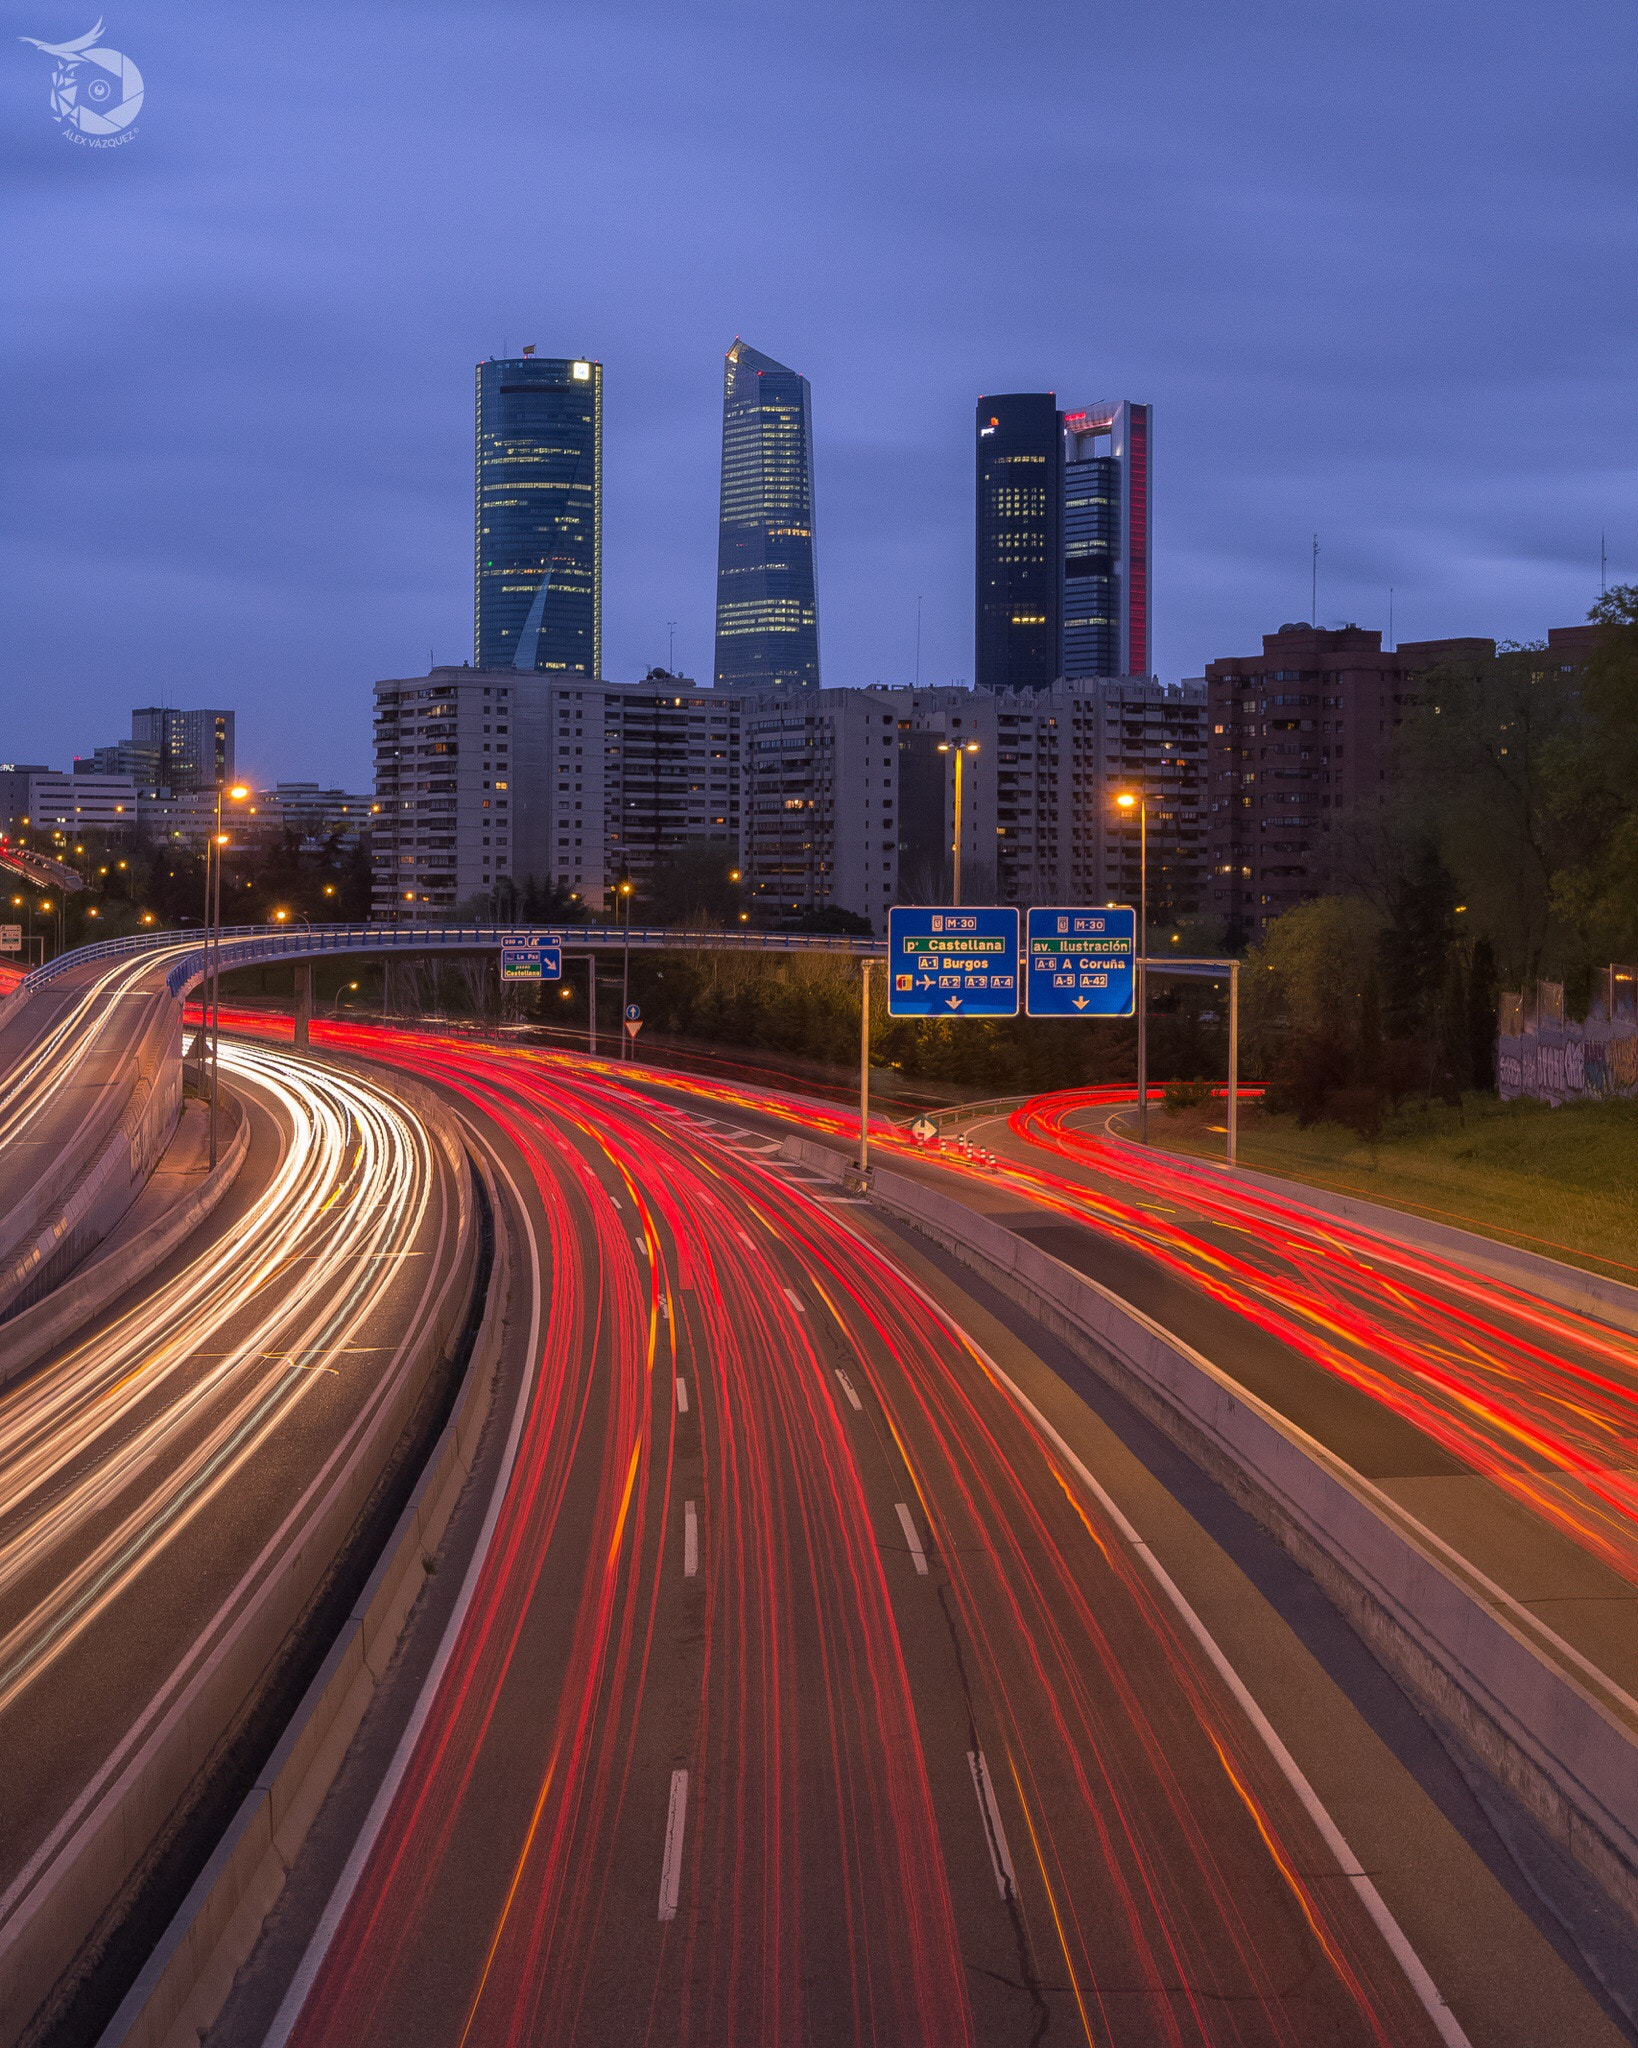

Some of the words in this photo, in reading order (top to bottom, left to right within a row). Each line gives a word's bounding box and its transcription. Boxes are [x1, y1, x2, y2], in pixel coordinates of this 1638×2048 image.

[947, 919, 974, 928] M-30
[1076, 921, 1103, 929] M-30
[929, 940, 1002, 951] Castellana
[1033, 943, 1051, 951] av.
[1060, 938, 1128, 951] Ilustración
[920, 959, 937, 967] A-1
[943, 958, 989, 972] Burgos
[1062, 959, 1072, 969] A
[1079, 958, 1126, 969] Coruña
[941, 978, 959, 986] A-2
[967, 978, 986, 986] A-3
[993, 978, 1011, 986] A-4
[1055, 976, 1073, 985] A-5
[1082, 976, 1106, 985] A-42
